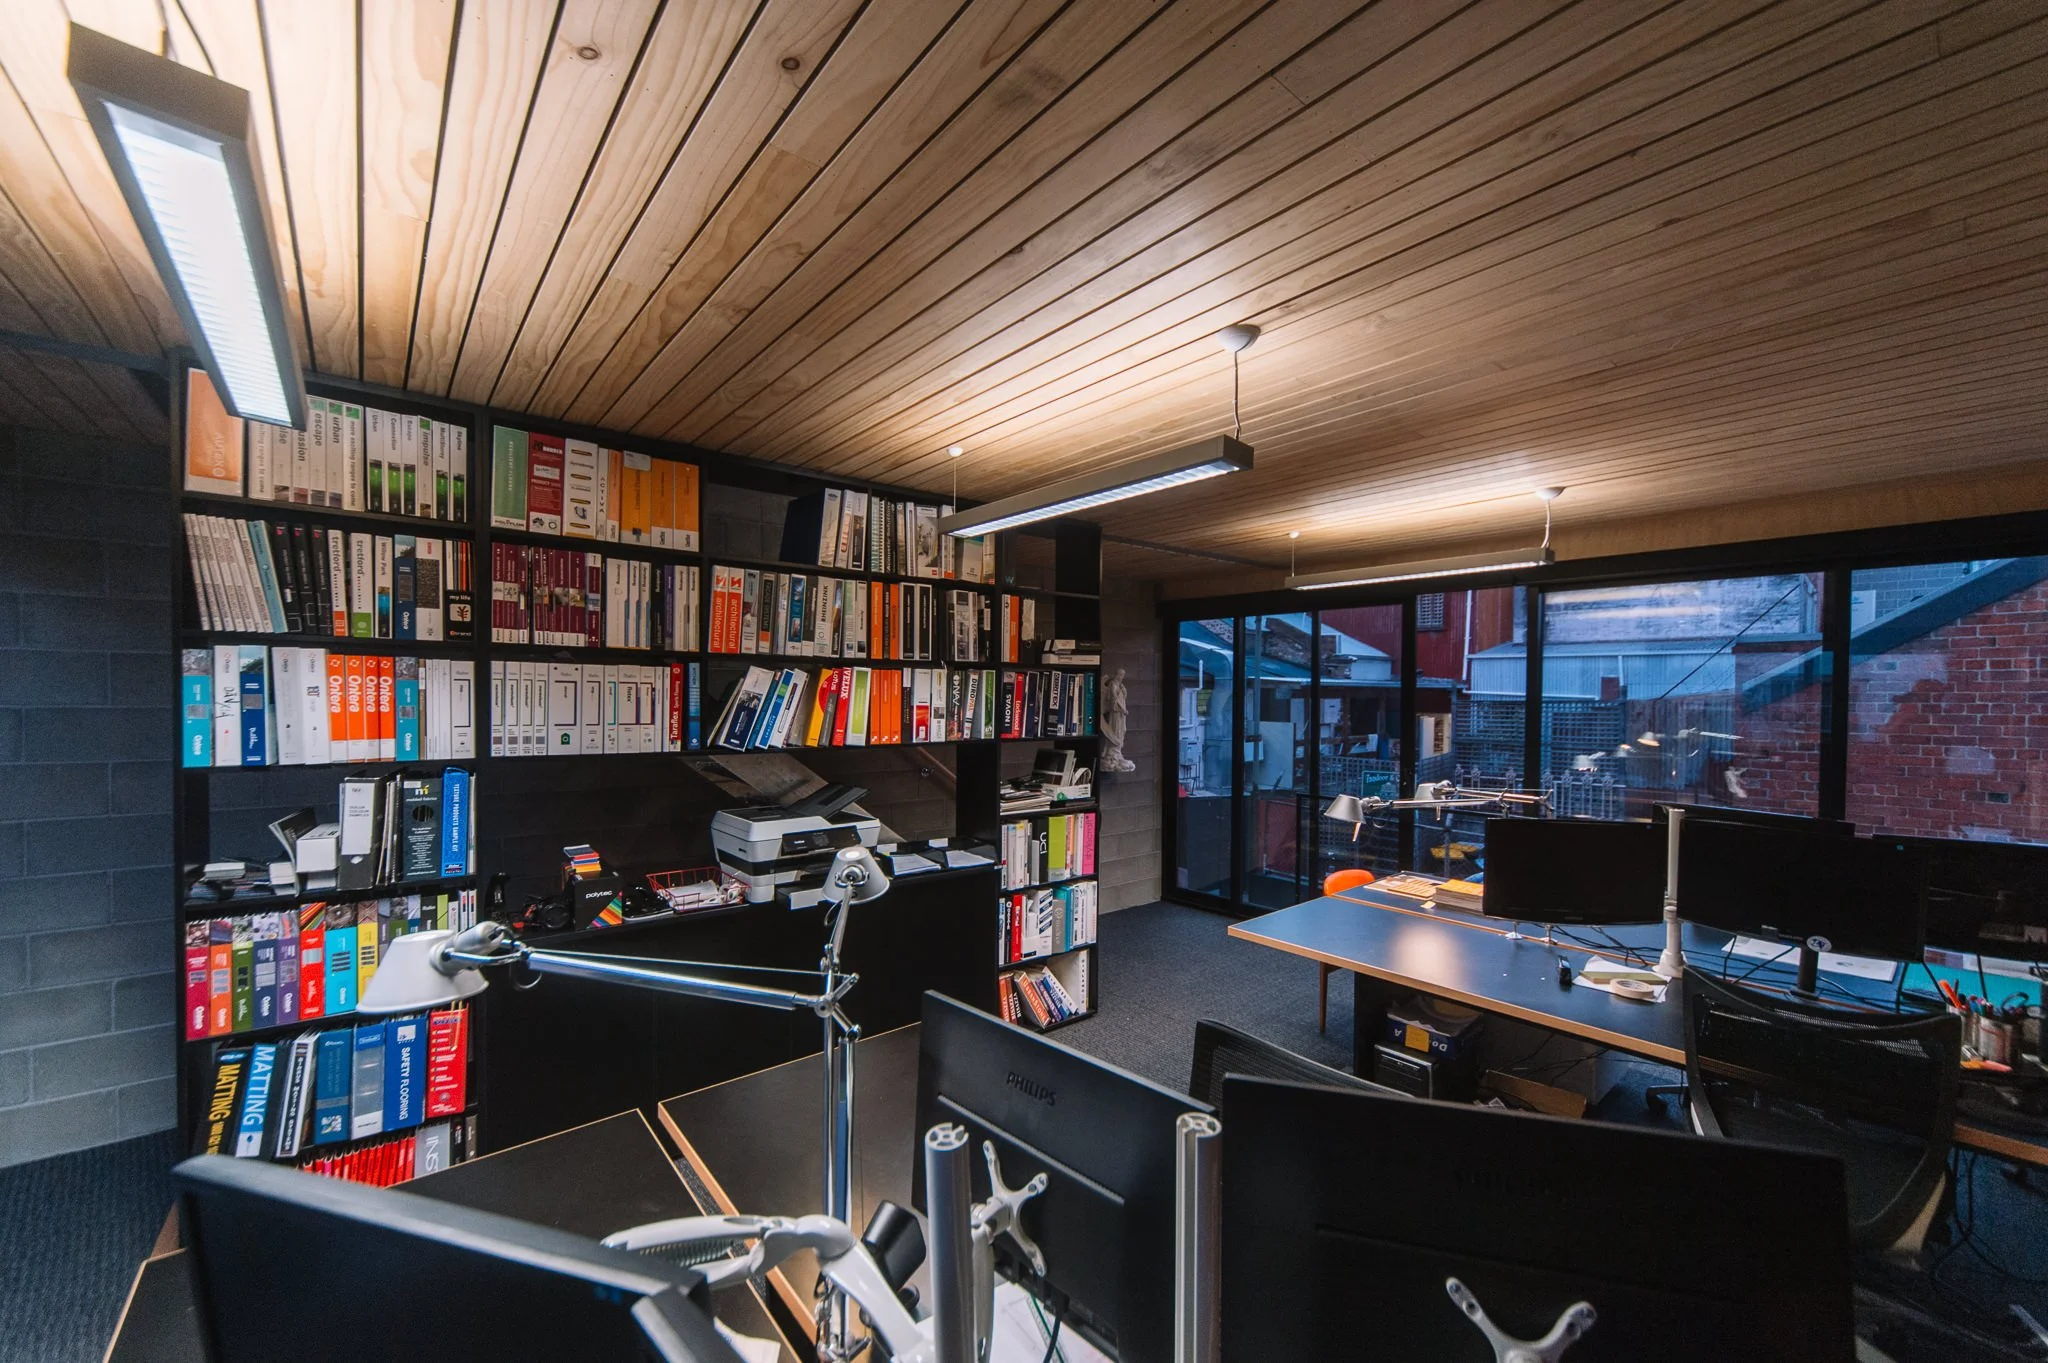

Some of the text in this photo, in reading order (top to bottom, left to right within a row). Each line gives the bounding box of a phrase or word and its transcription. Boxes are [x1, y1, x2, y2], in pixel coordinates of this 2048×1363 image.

[314, 413, 323, 447] escape
[332, 416, 342, 444] urban
[422, 431, 430, 467] impulse
[332, 536, 342, 576] tretford
[356, 539, 365, 577] tretford
[713, 596, 722, 649] architectural
[821, 585, 829, 622] RHEINZINK
[729, 599, 738, 649] architectural
[329, 675, 343, 713] Ontera
[348, 675, 362, 713] Ontera
[365, 675, 378, 713] Ontera
[379, 675, 393, 713] Ontera
[840, 668, 851, 699] VELUX
[966, 679, 978, 711] DUROPAL
[671, 711, 679, 739] Taraflex
[585, 889, 613, 899] polytec
[208, 1063, 241, 1122] MATTING
[242, 1046, 276, 1126] MATTING
[399, 1046, 411, 1121] SAFETY FLOORING
[1006, 1071, 1057, 1107] PHILIPS
